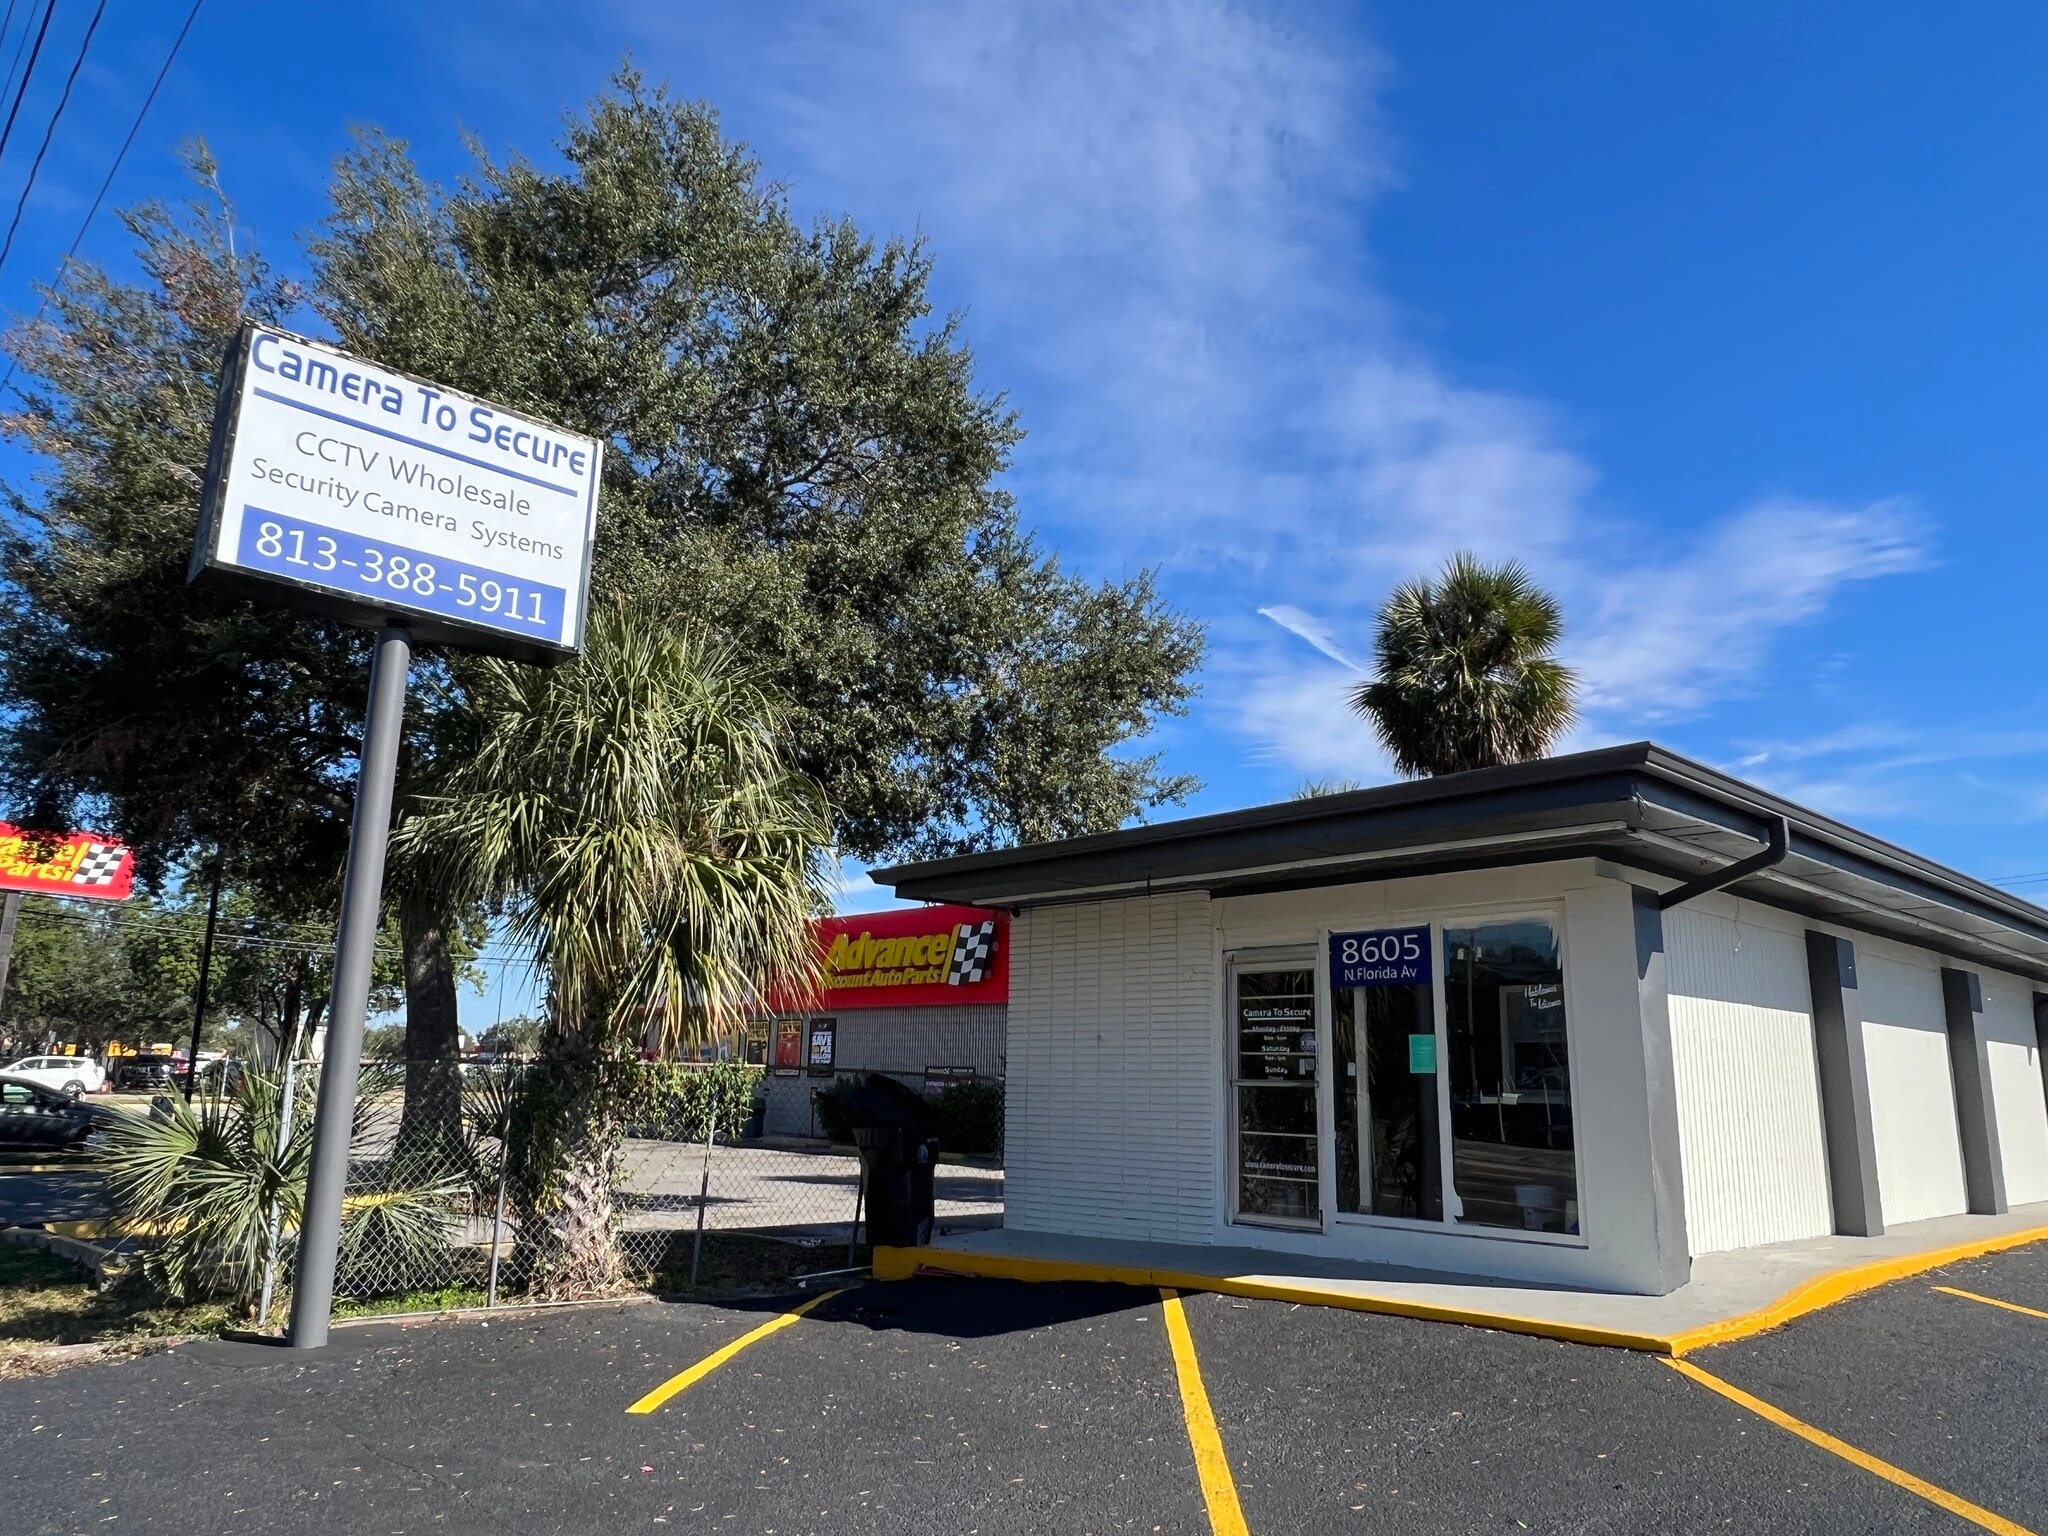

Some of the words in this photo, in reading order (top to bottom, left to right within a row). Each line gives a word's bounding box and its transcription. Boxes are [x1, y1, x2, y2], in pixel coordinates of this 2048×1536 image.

[252, 333, 403, 415] Camera
[417, 387, 457, 432] To
[468, 407, 586, 476] Secure
[296, 431, 379, 472] CCTV
[389, 456, 531, 516] Wholesale
[251, 457, 359, 508] Security
[363, 492, 457, 532] Camera
[470, 520, 563, 560] Systems
[256, 521, 547, 625] 813-388-5911
[823, 931, 950, 971] Advance
[1342, 934, 1420, 964] 8605
[1401, 965, 1417, 978] Av
[1273, 1008, 1283, 1016] To
[812, 1035, 832, 1046] SAVE
